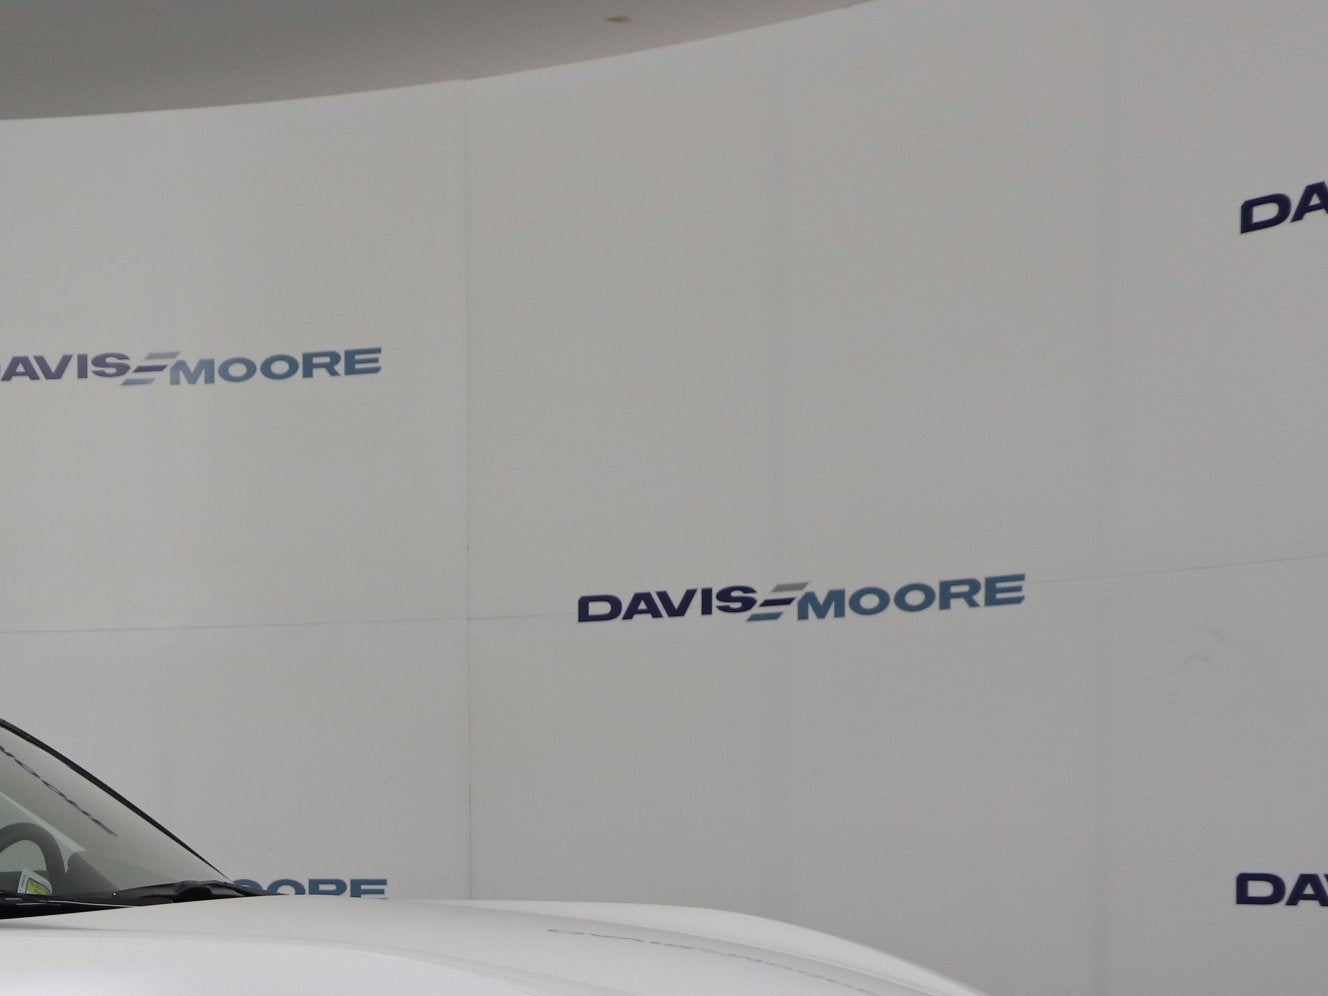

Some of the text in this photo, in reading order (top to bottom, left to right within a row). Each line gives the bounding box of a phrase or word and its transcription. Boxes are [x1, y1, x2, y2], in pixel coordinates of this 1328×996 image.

[170, 347, 381, 386] MOORE
[578, 574, 1026, 622] DAVIS MOORE
[1236, 873, 1328, 907] DA
